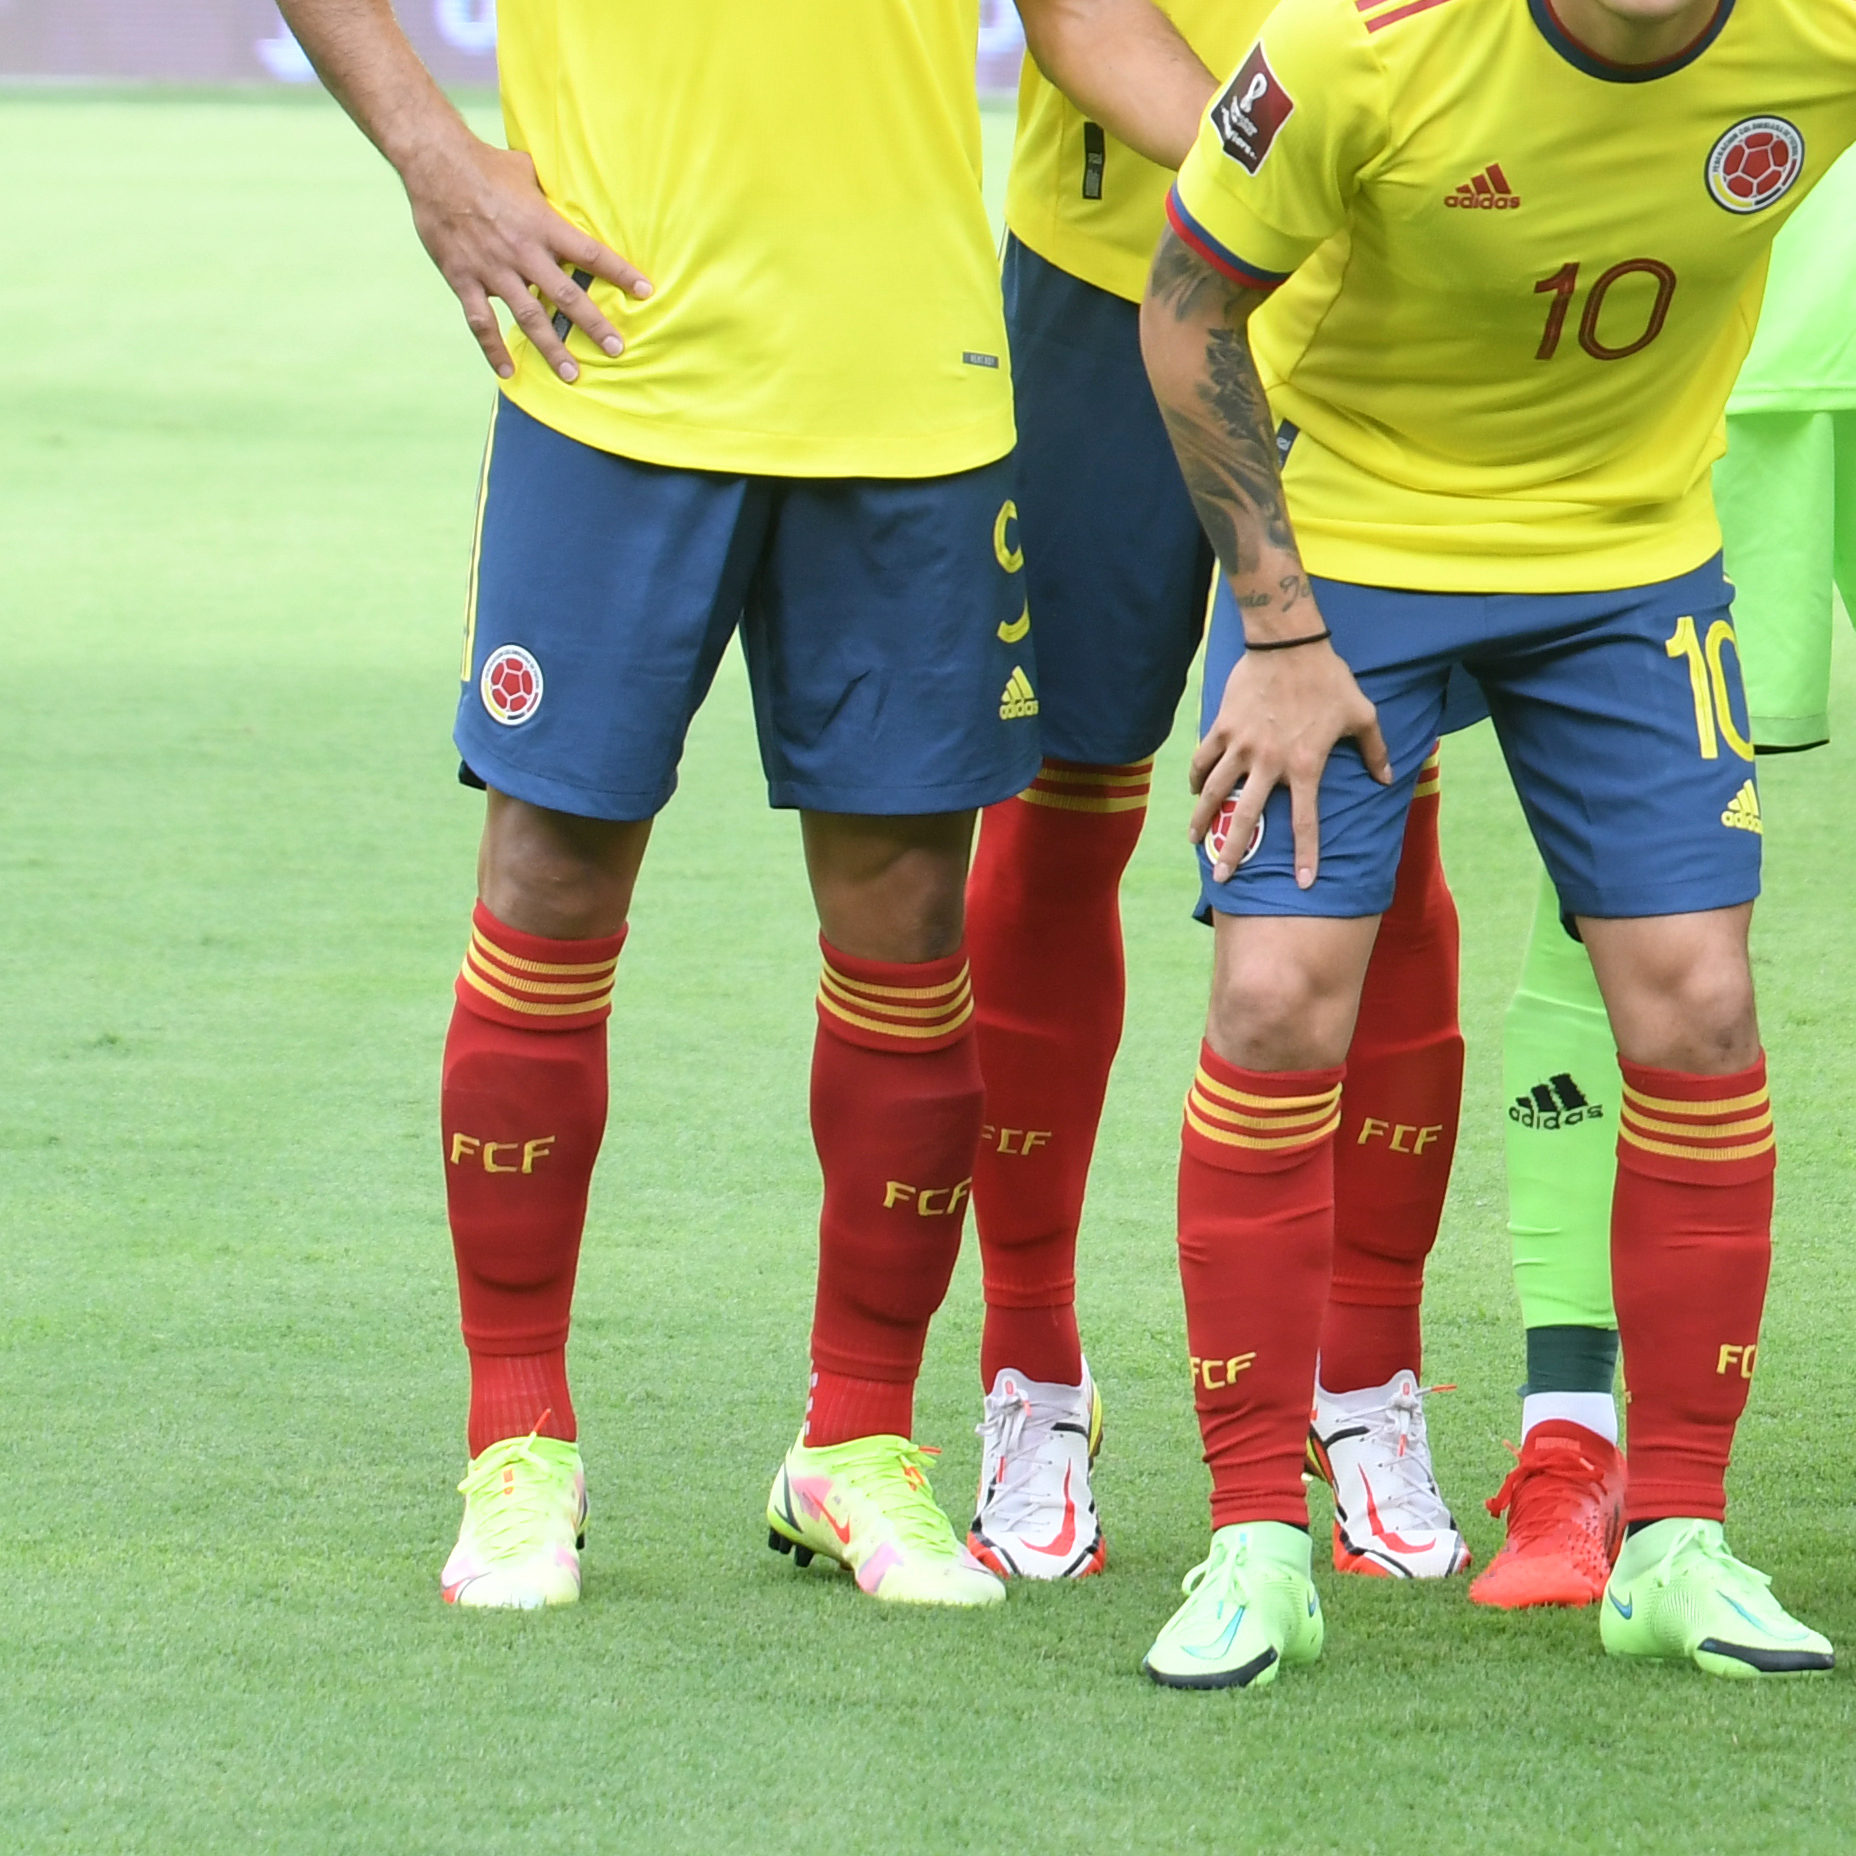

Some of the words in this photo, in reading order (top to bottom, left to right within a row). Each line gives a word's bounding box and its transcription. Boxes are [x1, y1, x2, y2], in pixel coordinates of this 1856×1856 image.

[1443, 188, 1521, 211] adidas
[1532, 257, 1678, 363] 10
[1356, 1116, 1443, 1156] FCF
[1508, 1104, 1604, 1131] adidas
[450, 1132, 556, 1174] FCF
[883, 1177, 973, 1217] FCF
[1189, 1352, 1258, 1391] FCF
[1716, 1343, 1758, 1382] FC
